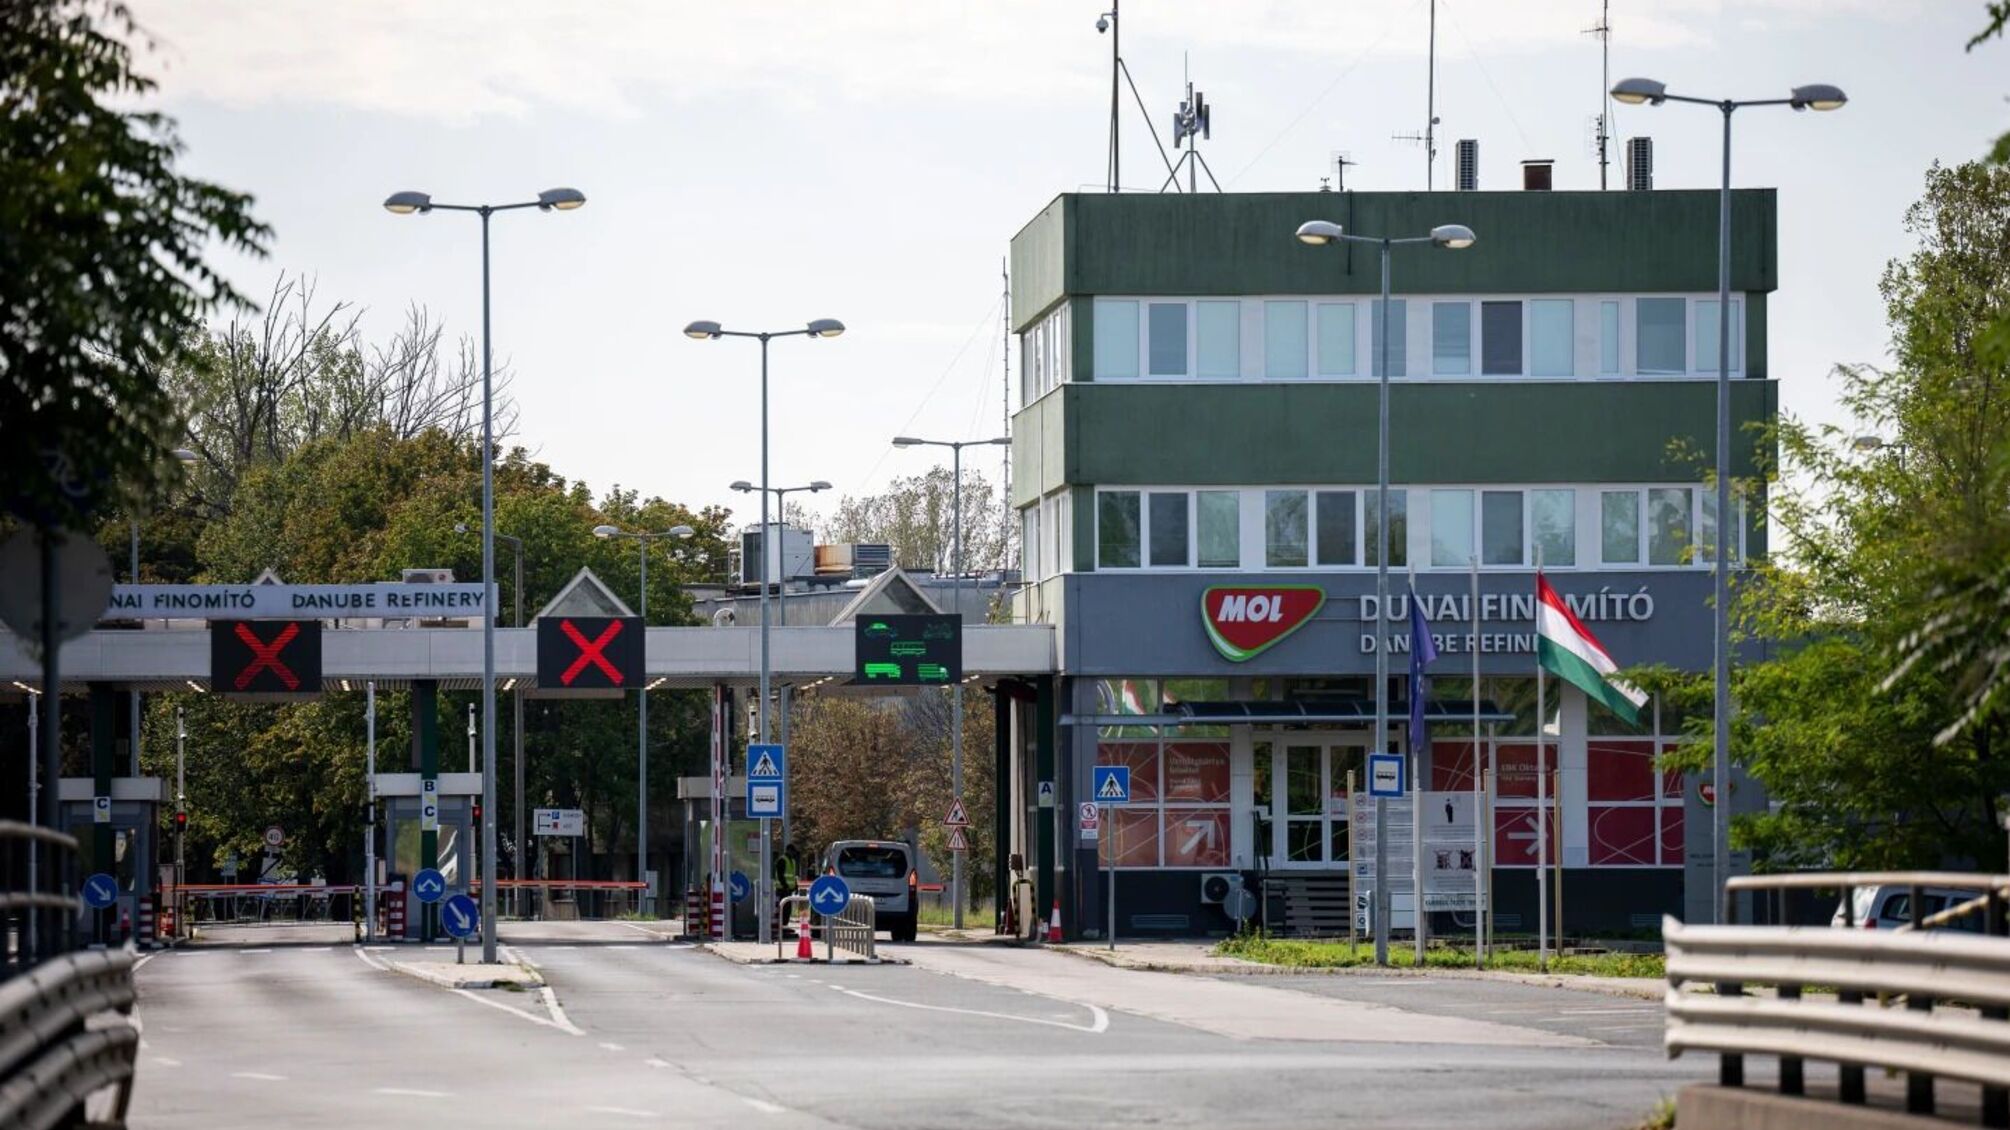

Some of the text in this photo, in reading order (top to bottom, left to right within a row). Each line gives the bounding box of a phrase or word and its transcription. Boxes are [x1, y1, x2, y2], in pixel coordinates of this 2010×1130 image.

[109, 590, 256, 608] NAI FINOMÍTÓ
[292, 592, 484, 608] DANUBE REFINERY
[1360, 585, 1654, 621] DUNAI FINMÍTÓ
[1217, 595, 1284, 623] MOL
[1361, 634, 1538, 653] DNBE REFIN
[424, 781, 435, 792] B
[1041, 782, 1052, 794] A
[97, 797, 108, 809] C
[424, 806, 435, 817] C
